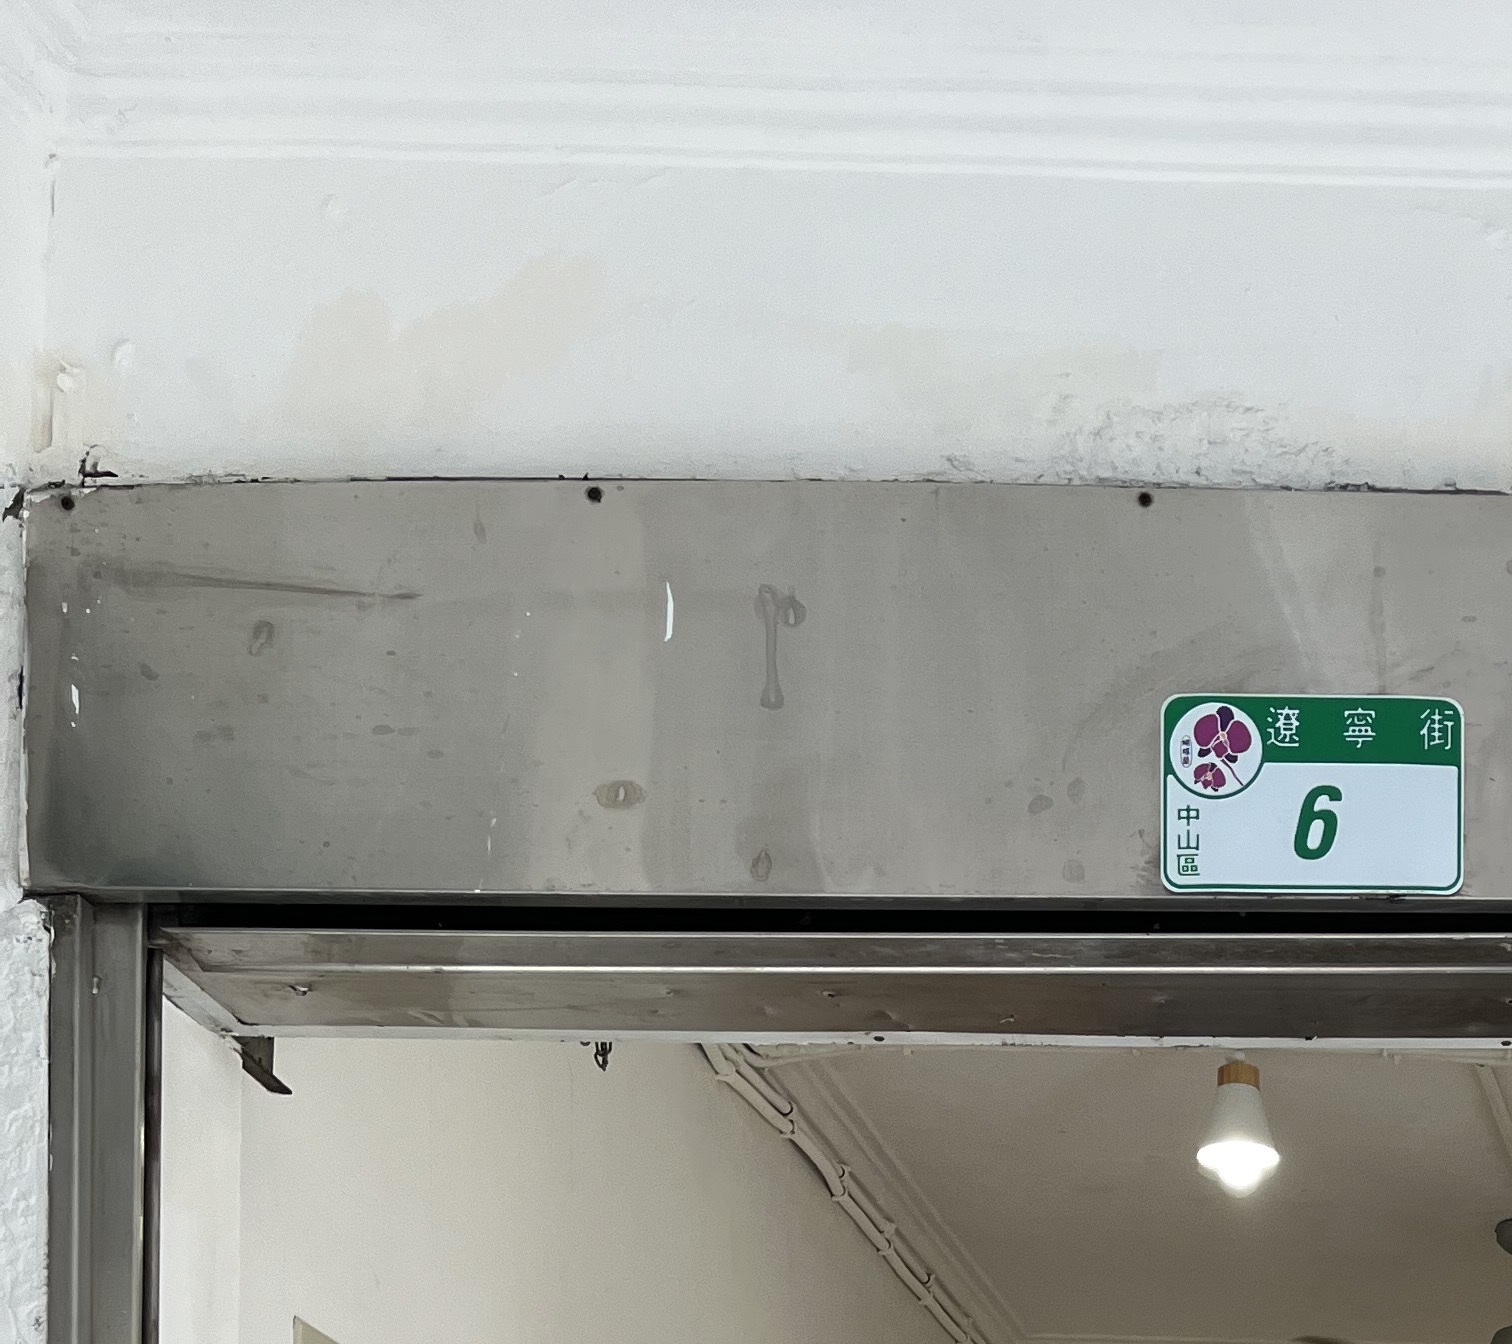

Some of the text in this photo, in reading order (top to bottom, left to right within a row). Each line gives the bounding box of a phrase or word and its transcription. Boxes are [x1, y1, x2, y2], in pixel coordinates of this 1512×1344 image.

[1267, 706, 1455, 750] 遼寧街
[1176, 804, 1200, 876] 中山區
[1293, 784, 1343, 860] 6
